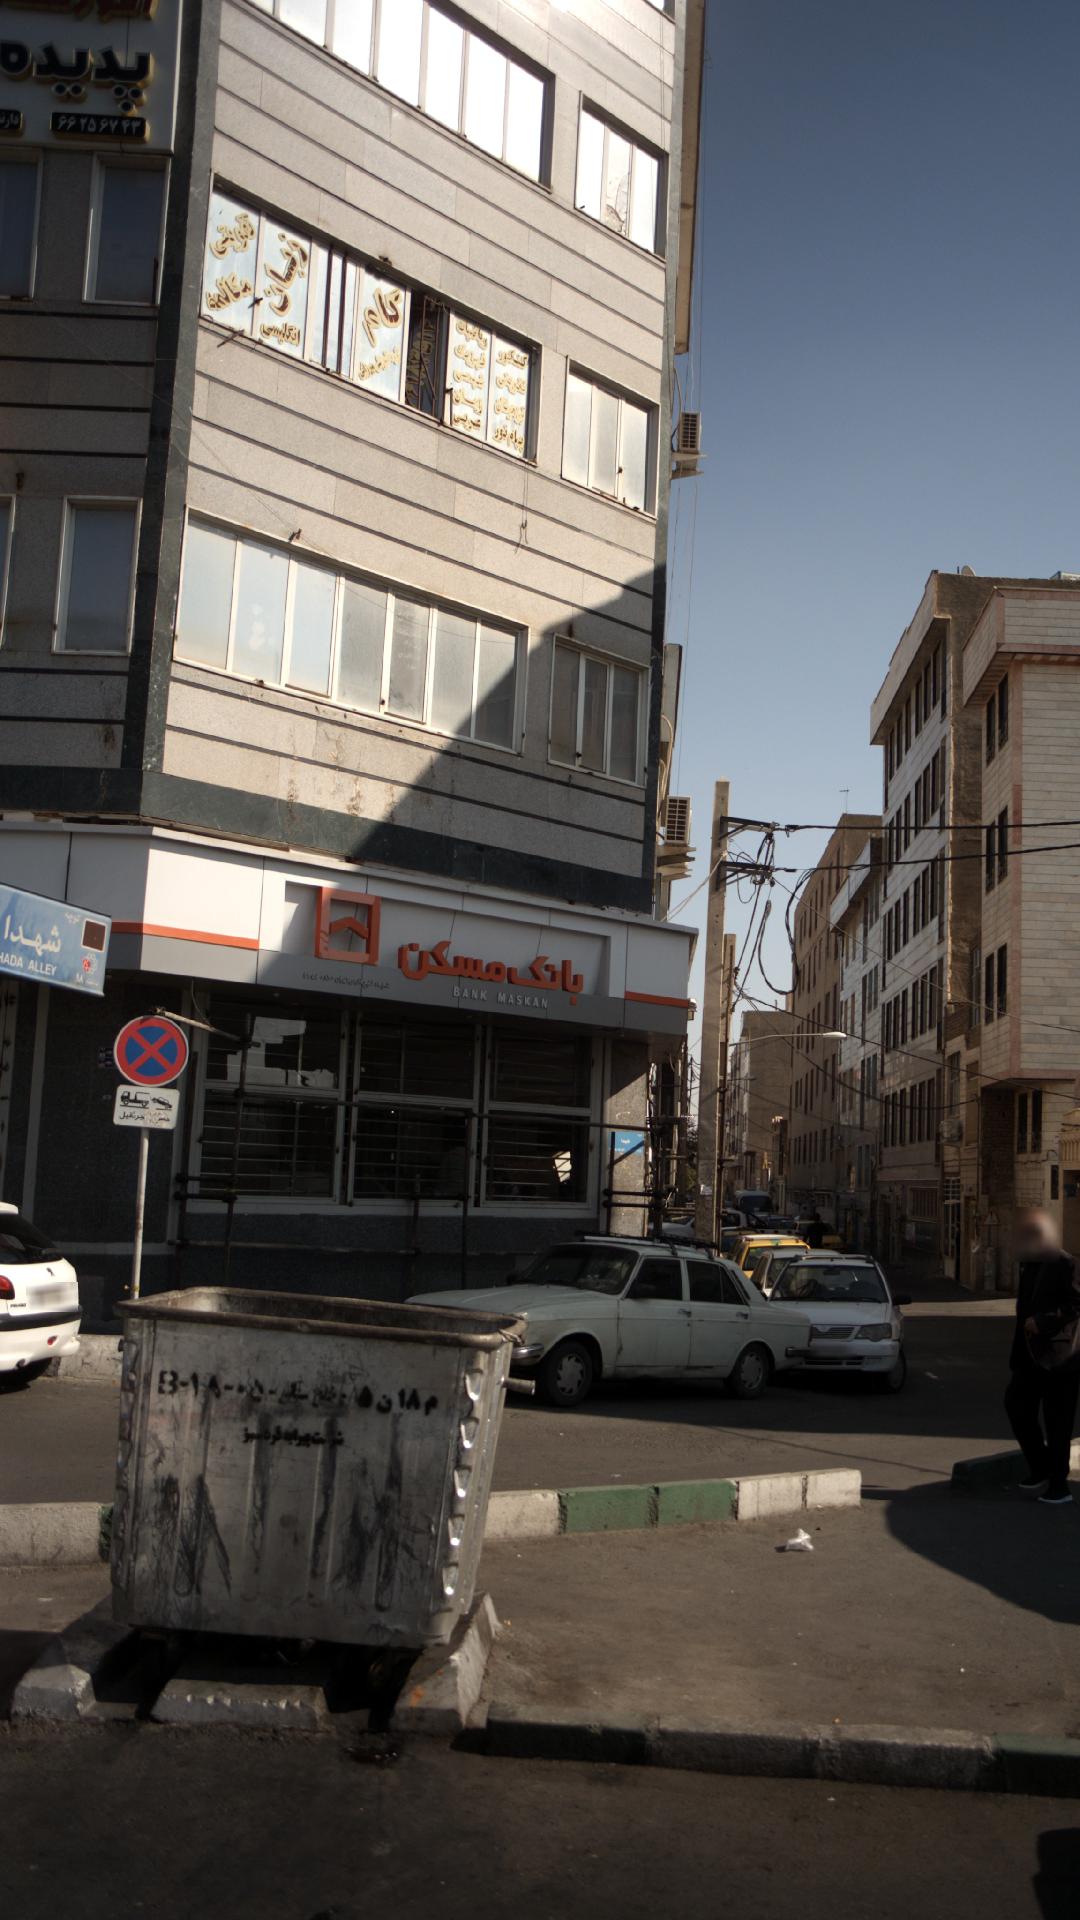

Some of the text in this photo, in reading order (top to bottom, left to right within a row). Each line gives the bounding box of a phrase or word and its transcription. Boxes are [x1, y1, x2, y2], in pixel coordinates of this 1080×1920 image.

[206, 272, 253, 311] مکالمه
[259, 323, 300, 346] انگلیسی
[496, 350, 528, 369] کنکور
[4, 914, 61, 957] شهدا
[28, 959, 57, 977] ALLEY
[398, 940, 506, 983] مسکن
[507, 956, 584, 1006] بانک
[453, 985, 548, 1009] BANK MASKAN
